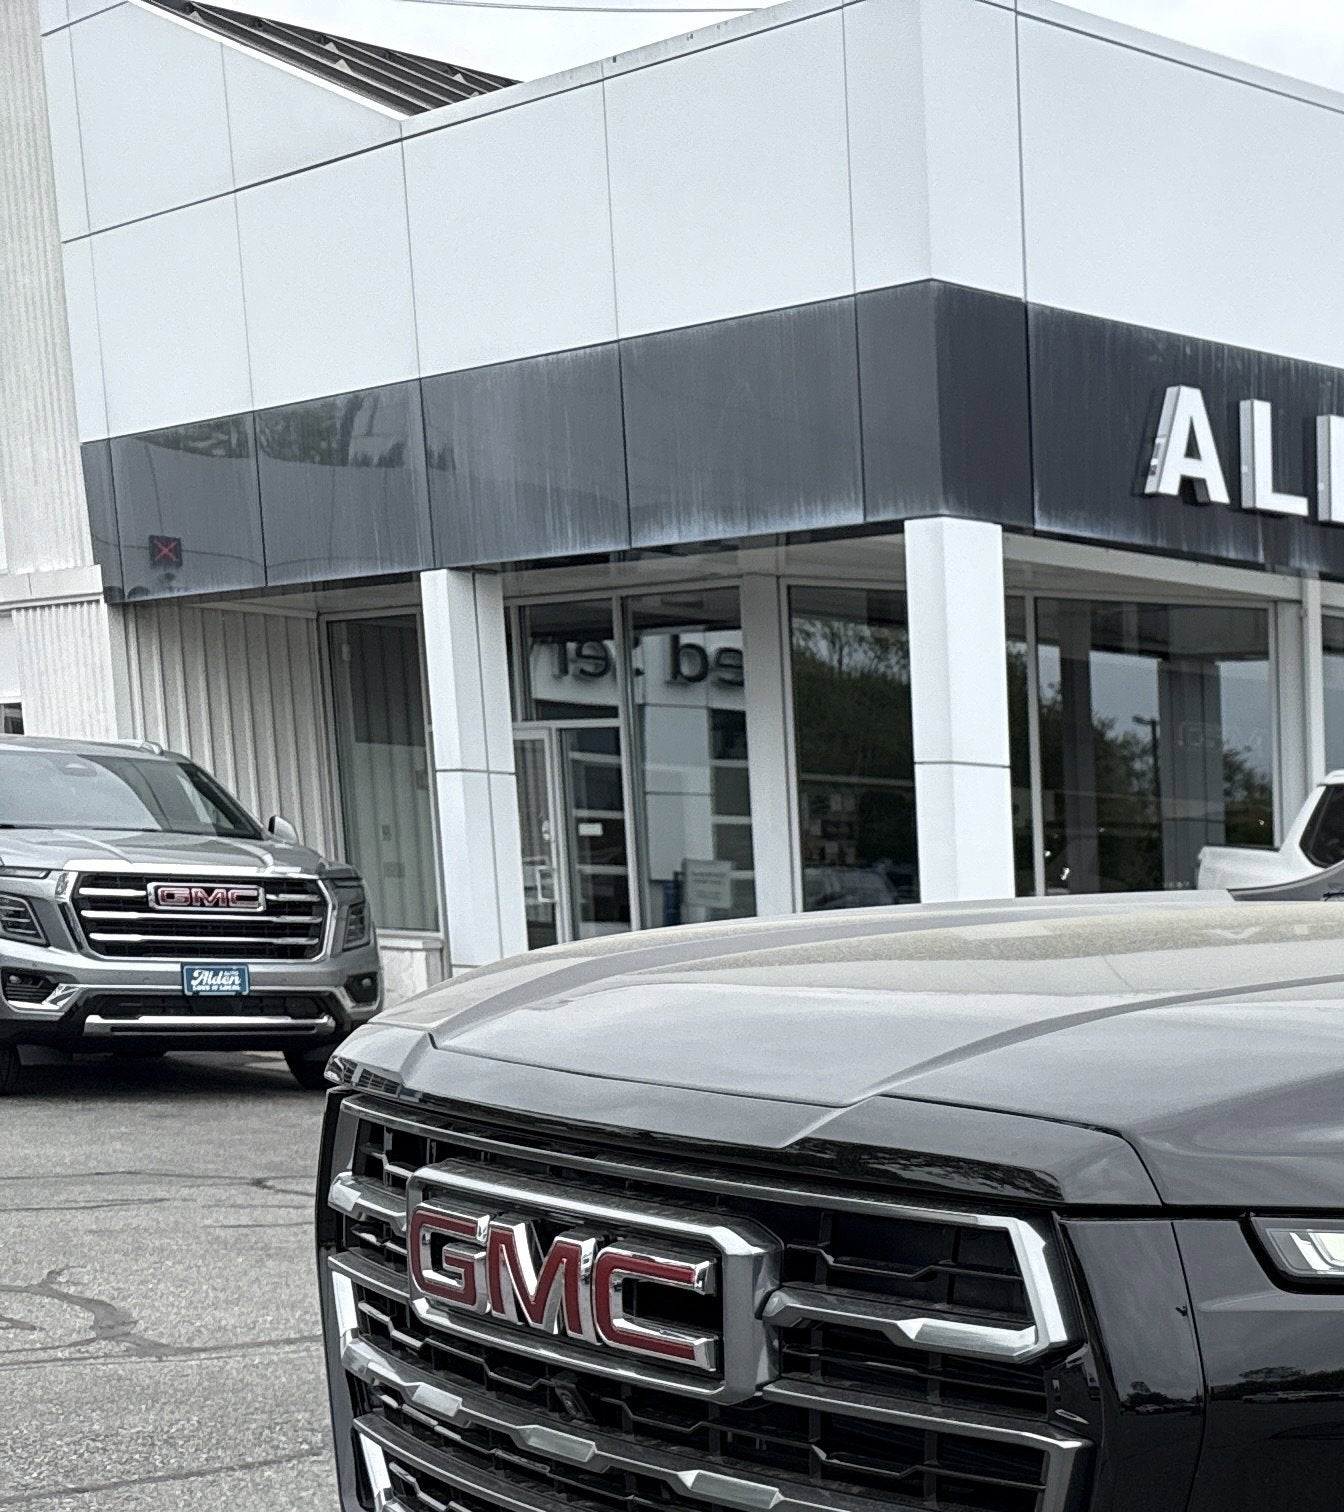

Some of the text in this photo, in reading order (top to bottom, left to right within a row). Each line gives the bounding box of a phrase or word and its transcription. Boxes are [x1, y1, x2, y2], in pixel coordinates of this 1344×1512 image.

[157, 887, 260, 908] GMC
[190, 969, 242, 985] Alden
[410, 1202, 718, 1372] GMC
